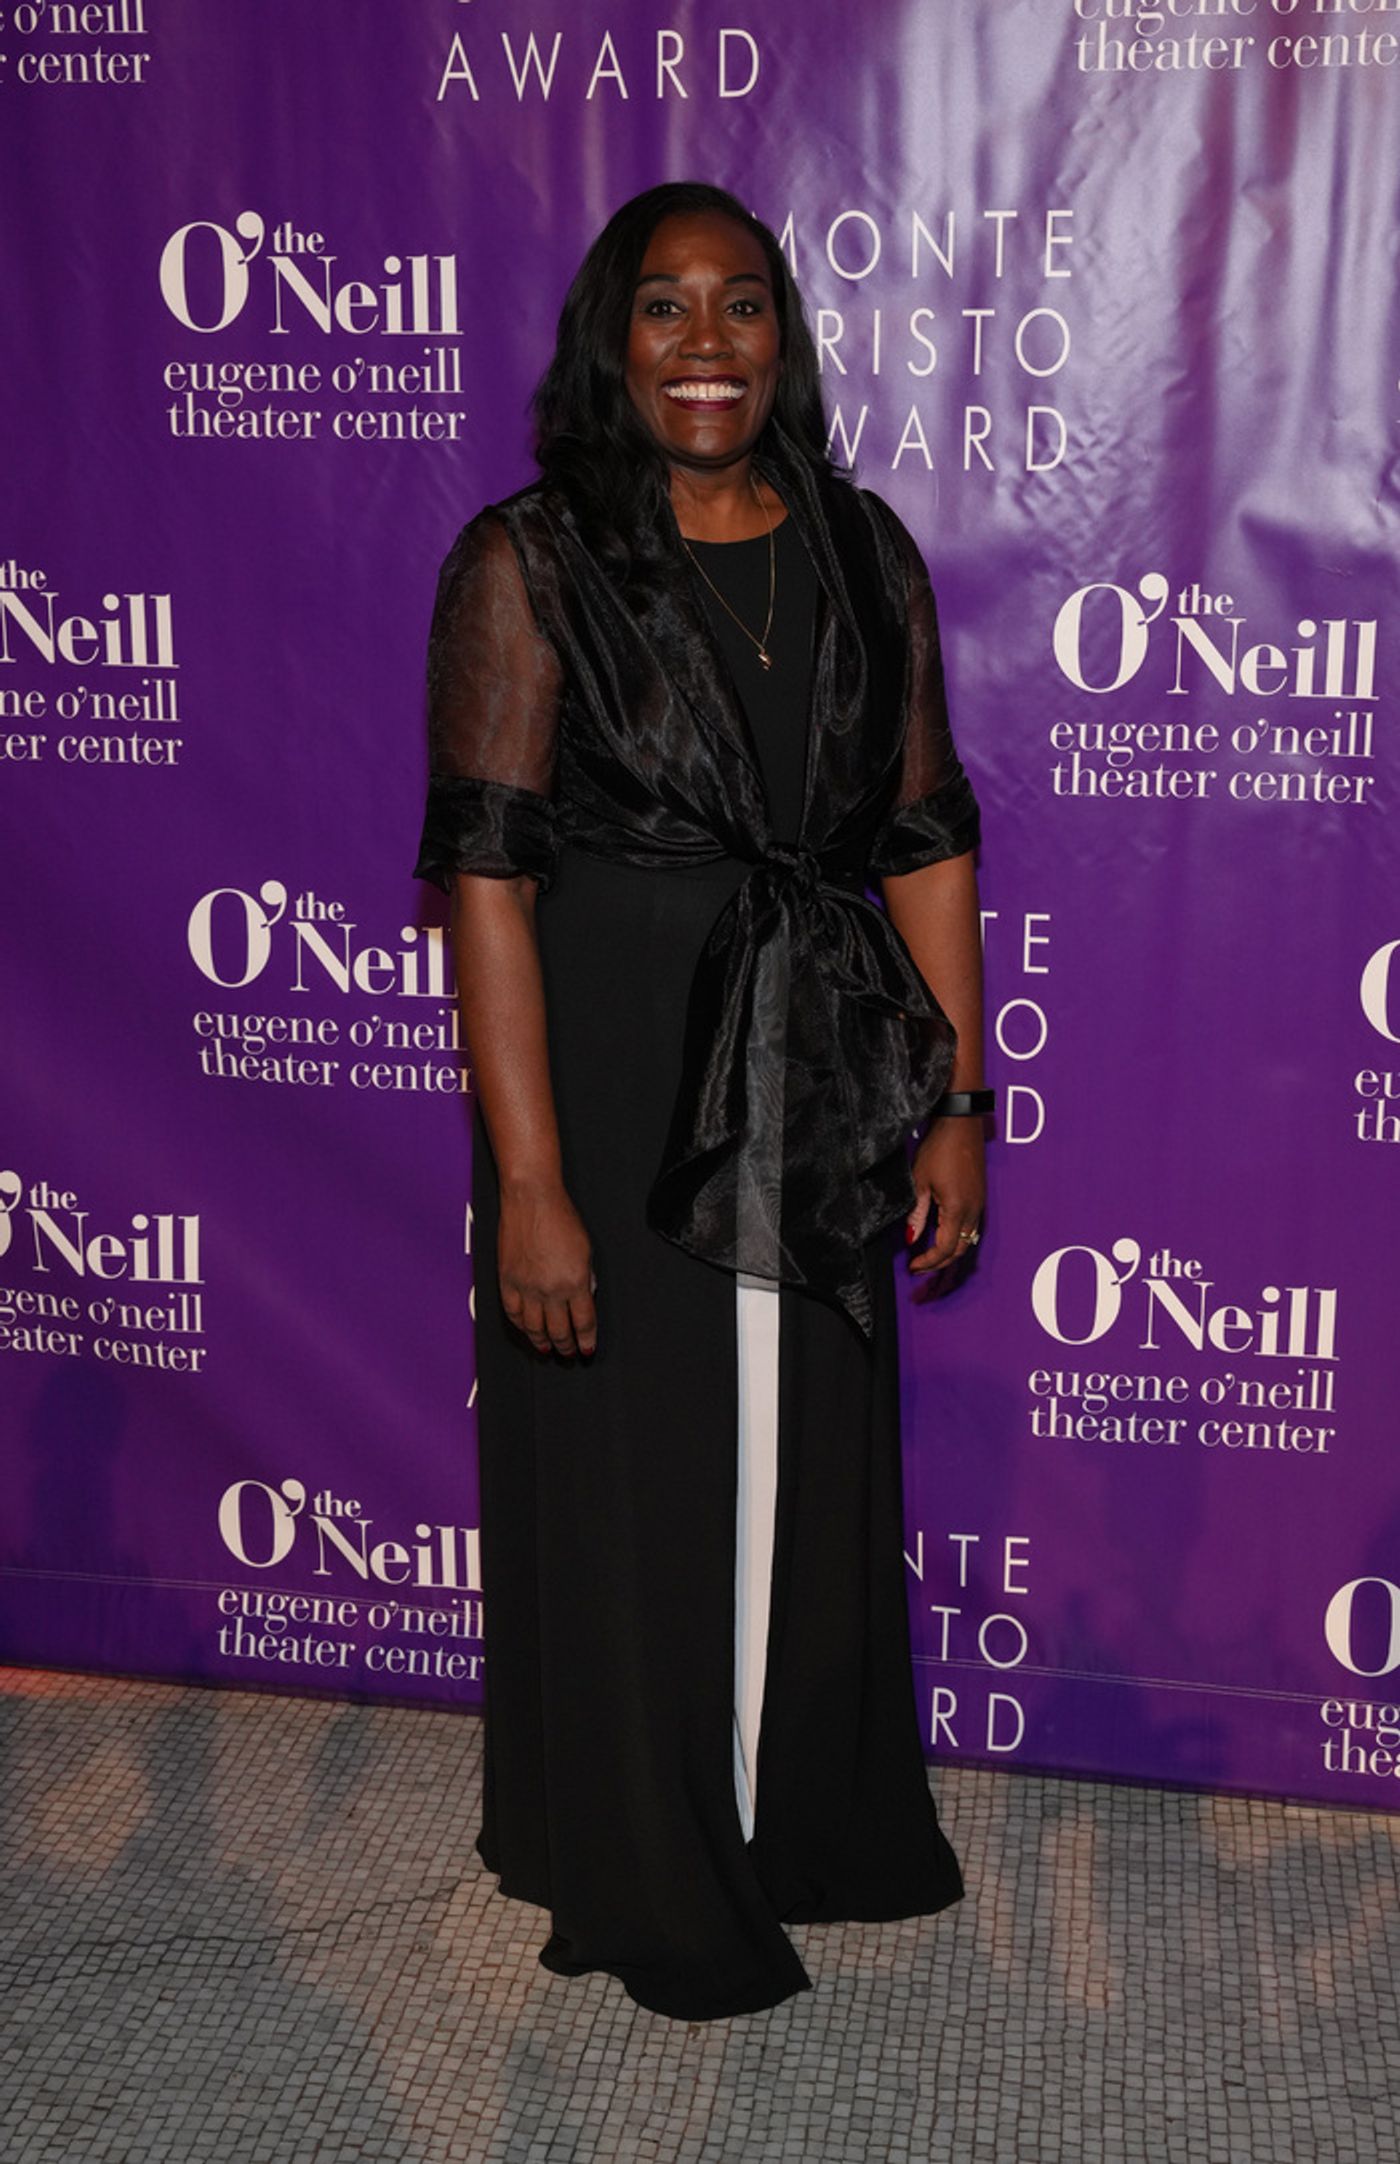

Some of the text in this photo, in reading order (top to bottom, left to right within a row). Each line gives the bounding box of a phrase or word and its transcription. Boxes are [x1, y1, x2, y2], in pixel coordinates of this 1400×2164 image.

[18, 46, 151, 84] center
[436, 29, 760, 101] AWARD
[1074, 20, 1400, 72] theater cente
[272, 221, 325, 254] the
[158, 210, 464, 335] O'Neill
[817, 307, 1071, 378] RISTO
[163, 348, 464, 406] eugene o'neill
[167, 393, 466, 441] theater center
[825, 404, 1067, 471] WARD
[1177, 584, 1234, 616] the
[0, 591, 179, 668] Neill
[1053, 572, 1380, 700] O'Neill
[56, 679, 181, 722] o'neill
[58, 732, 183, 765] center
[1050, 711, 1375, 767] eugene o'neill
[1050, 752, 1375, 804] theater center
[295, 891, 346, 921] the
[187, 880, 459, 999] O'Neil
[193, 1009, 467, 1054] eugene o'neil
[198, 1038, 340, 1087] theater
[29, 1181, 78, 1210] the
[0, 1170, 205, 1284] 'Neill
[1148, 1249, 1203, 1280] the
[0, 1287, 205, 1333] gene o'neill
[1031, 1238, 1340, 1361] O'Neill
[0, 1323, 206, 1372] eater center
[1028, 1368, 1336, 1414] eugene o'neill
[1028, 1397, 1336, 1454] theater center
[313, 1490, 362, 1518] the
[218, 1478, 483, 1592] O'Neill
[217, 1588, 485, 1639] eugene o'neill
[217, 1616, 485, 1681] theater center
